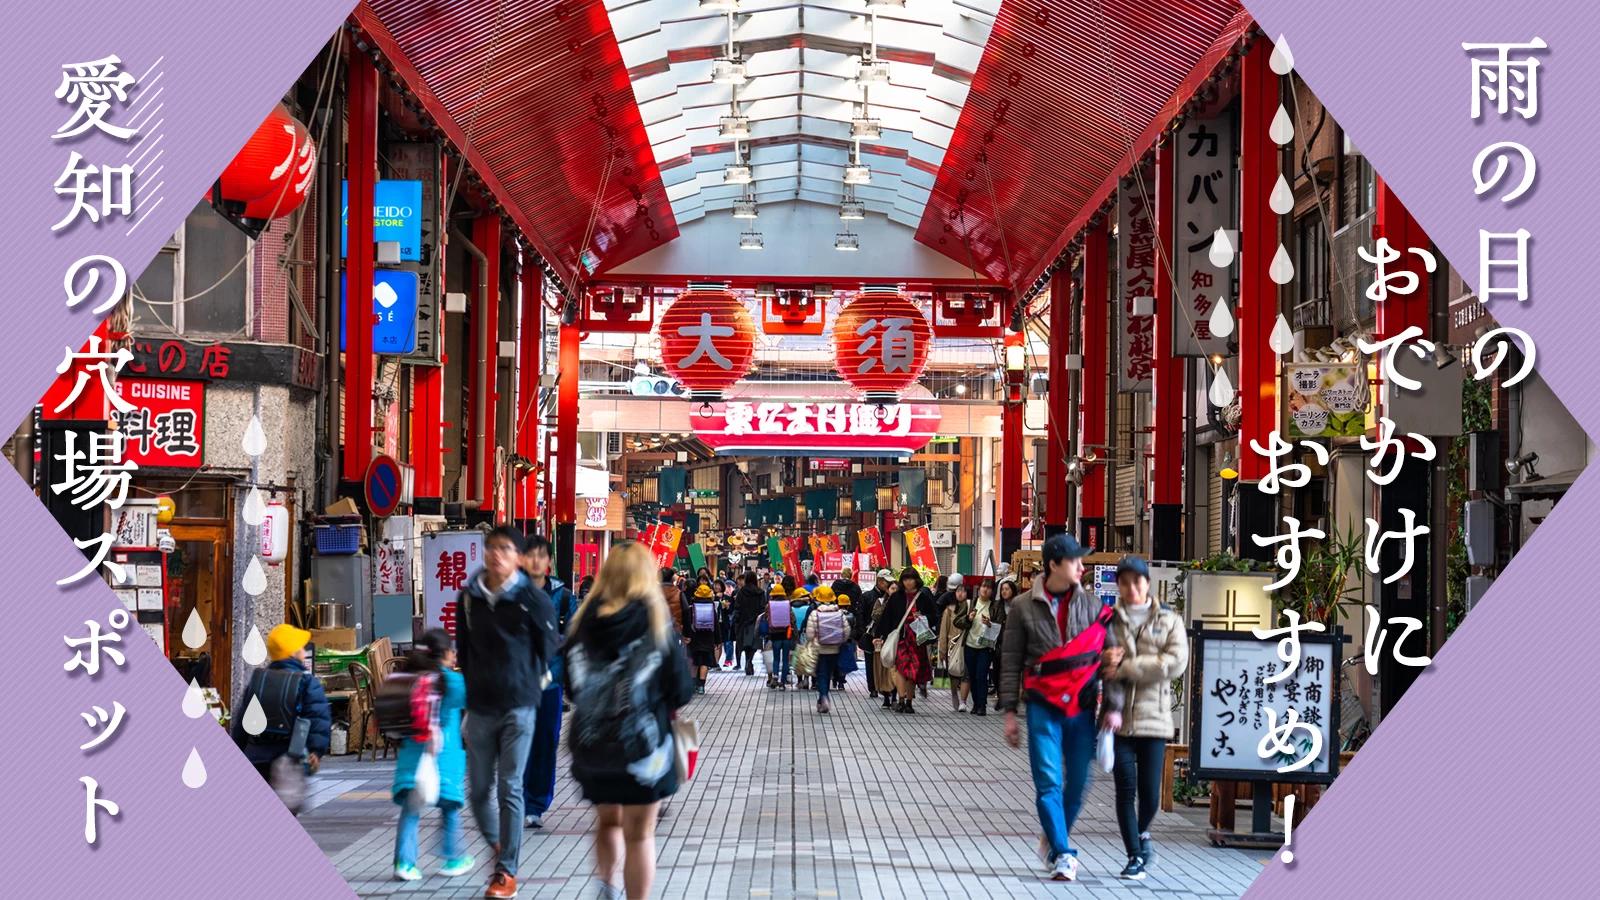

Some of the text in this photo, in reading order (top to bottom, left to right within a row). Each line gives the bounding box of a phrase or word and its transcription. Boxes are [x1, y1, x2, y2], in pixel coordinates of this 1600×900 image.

[1187, 124, 1223, 253] カバン
[1191, 269, 1213, 340] 知多屋
[677, 312, 735, 370] 大
[856, 317, 915, 374] 須
[131, 383, 191, 400] CUISINE
[1295, 370, 1320, 379] オーラ
[1299, 380, 1317, 389] 撮影
[111, 407, 200, 456] 料理
[1293, 411, 1328, 419] ヒーリング
[379, 548, 392, 594] かんざし
[1238, 669, 1251, 726] うなぎの
[1253, 665, 1266, 730] ご利用下さい
[1304, 656, 1324, 728] 御商談
